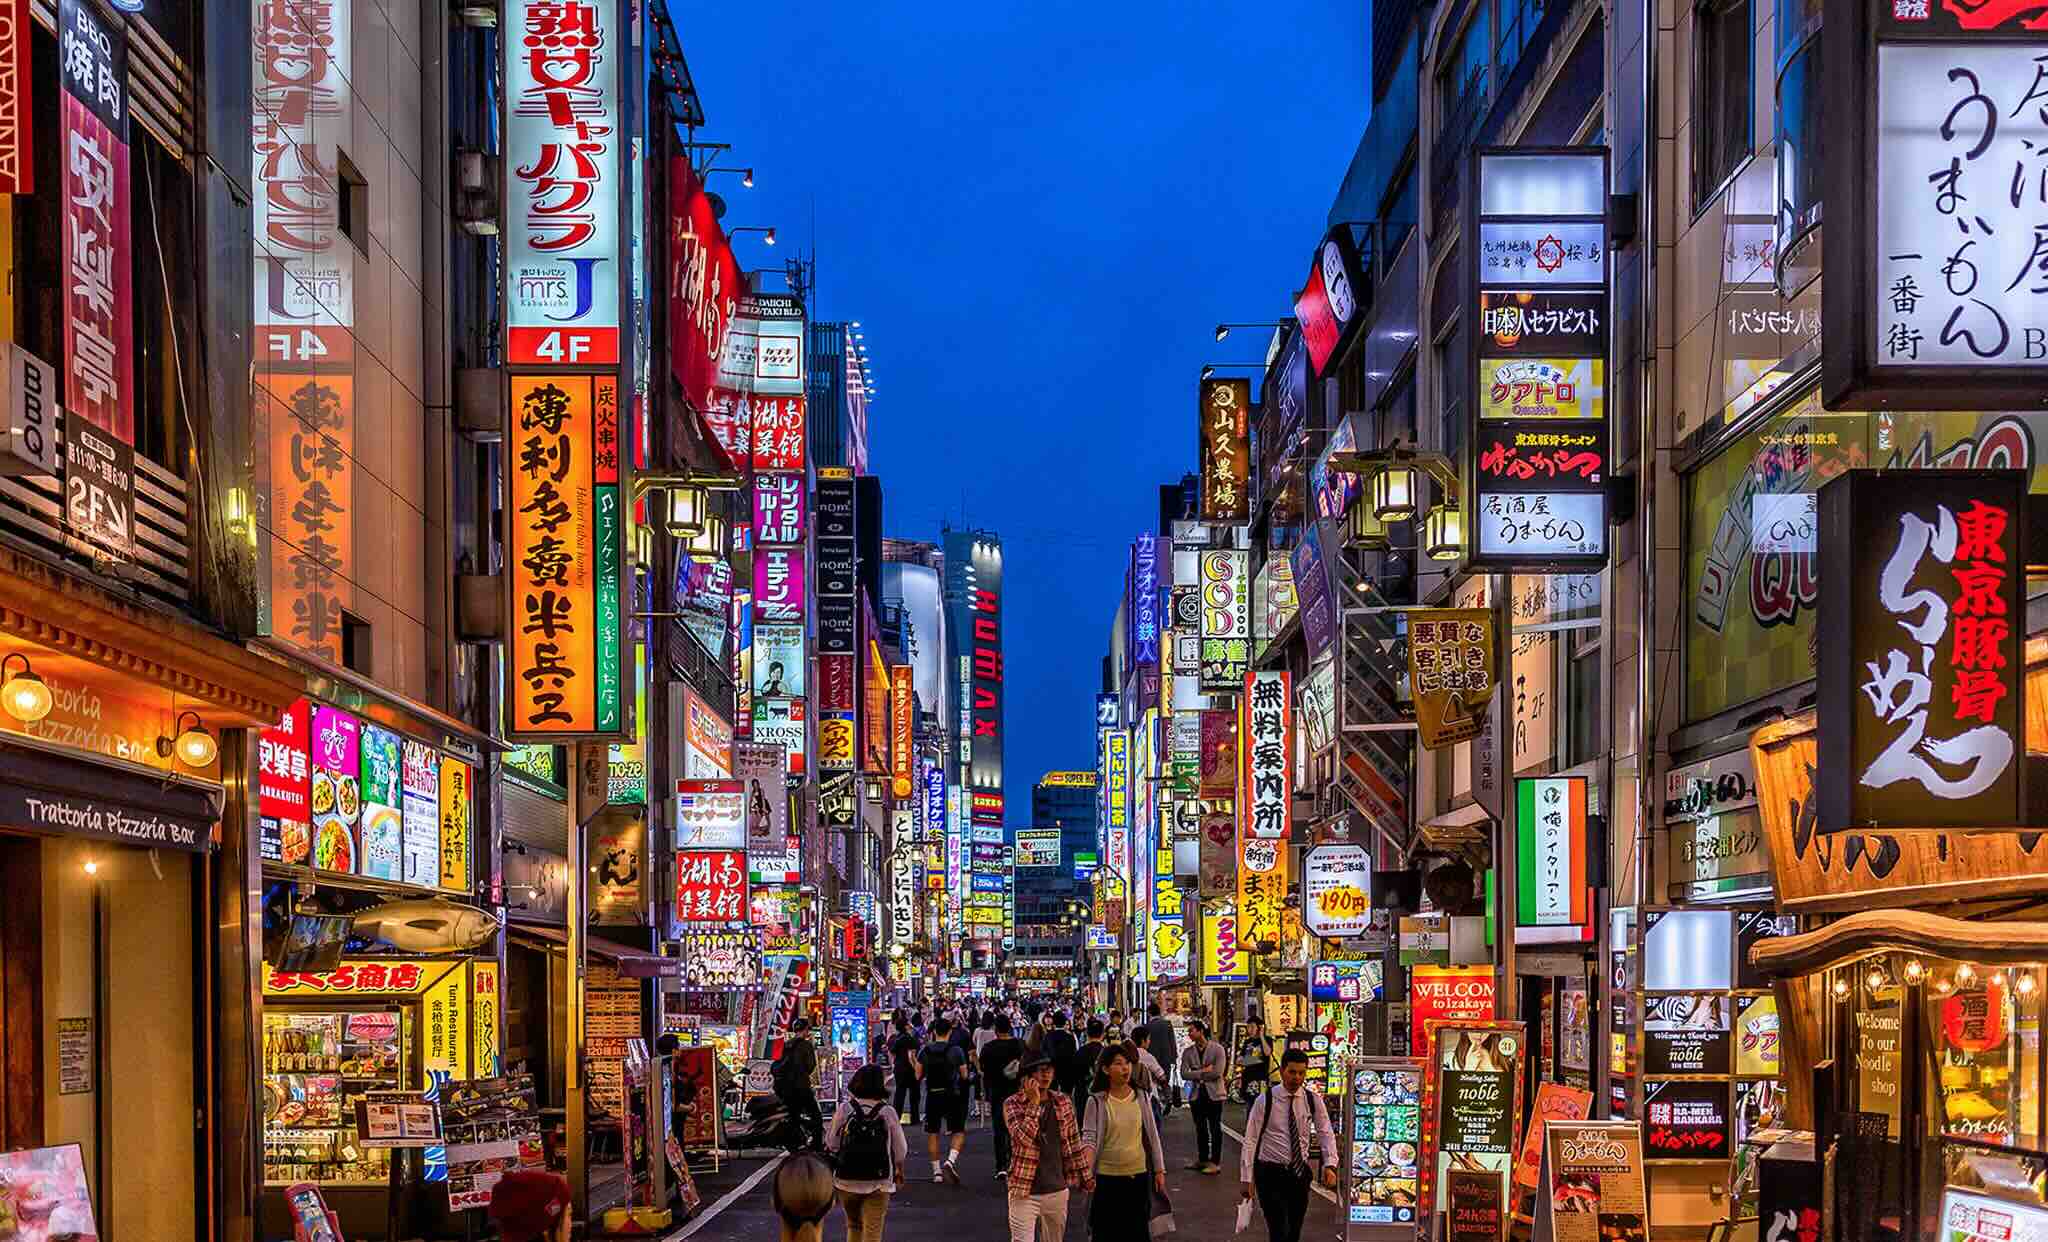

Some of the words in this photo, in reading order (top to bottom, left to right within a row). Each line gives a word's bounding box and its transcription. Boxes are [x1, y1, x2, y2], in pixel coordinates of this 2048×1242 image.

[77, 8, 111, 60] BBQ
[65, 30, 120, 120] 焼肉
[1929, 67, 2010, 358] うまいもん
[544, 257, 610, 321] J
[1484, 307, 1600, 336] 日本人セラピスト
[1884, 259, 1925, 364] 一番街
[535, 331, 591, 362] 4F
[1490, 384, 1576, 405] クアトロ
[24, 360, 43, 461] BBQ
[596, 386, 616, 469] 炭火串焼
[1514, 433, 1597, 447] 東京豚骨ラーメン
[1483, 496, 1551, 516] 居酒屋
[1137, 536, 1156, 662] カラオケの鉄人
[1951, 499, 2008, 721] 東京豚骨
[1413, 621, 1484, 645] 悪質な
[1414, 646, 1486, 670] 客引き
[1221, 662, 1248, 680] 4F
[1416, 670, 1489, 694] に注意
[755, 727, 803, 737] XROSS
[1254, 681, 1286, 832] 無料案内所
[704, 783, 719, 792] 2F
[929, 770, 944, 820] カラオケ
[26, 798, 103, 831] Trattoria
[106, 811, 168, 840] Pizzeria
[169, 823, 195, 844] Bar
[1246, 847, 1275, 863] 新宿
[1541, 809, 1563, 910] 俺のイタリアン
[682, 853, 743, 889] 湖南
[756, 861, 793, 872] CASA
[694, 889, 743, 921] 菜館
[1243, 873, 1266, 943] まっちゃん
[1321, 890, 1366, 912] 190円
[1646, 913, 1661, 926] 5F
[1738, 913, 1753, 926] 4F
[447, 983, 458, 1004] Tuna
[1433, 998, 1446, 1009] to
[1447, 998, 1494, 1010] Izakaya
[1646, 999, 1660, 1011] 3F
[1738, 999, 1752, 1011] 2F
[1856, 1011, 1900, 1032] Welcome
[447, 1007, 459, 1068] Restaurant
[1860, 1036, 1875, 1051] To
[1877, 1039, 1896, 1051] our
[1668, 1046, 1705, 1063] noble
[1856, 1054, 1893, 1074] Noodle
[1458, 1083, 1500, 1101] noble
[1645, 1084, 1660, 1096] 1F
[1871, 1078, 1897, 1098] shop
[1673, 1105, 1715, 1115] RA-MEN
